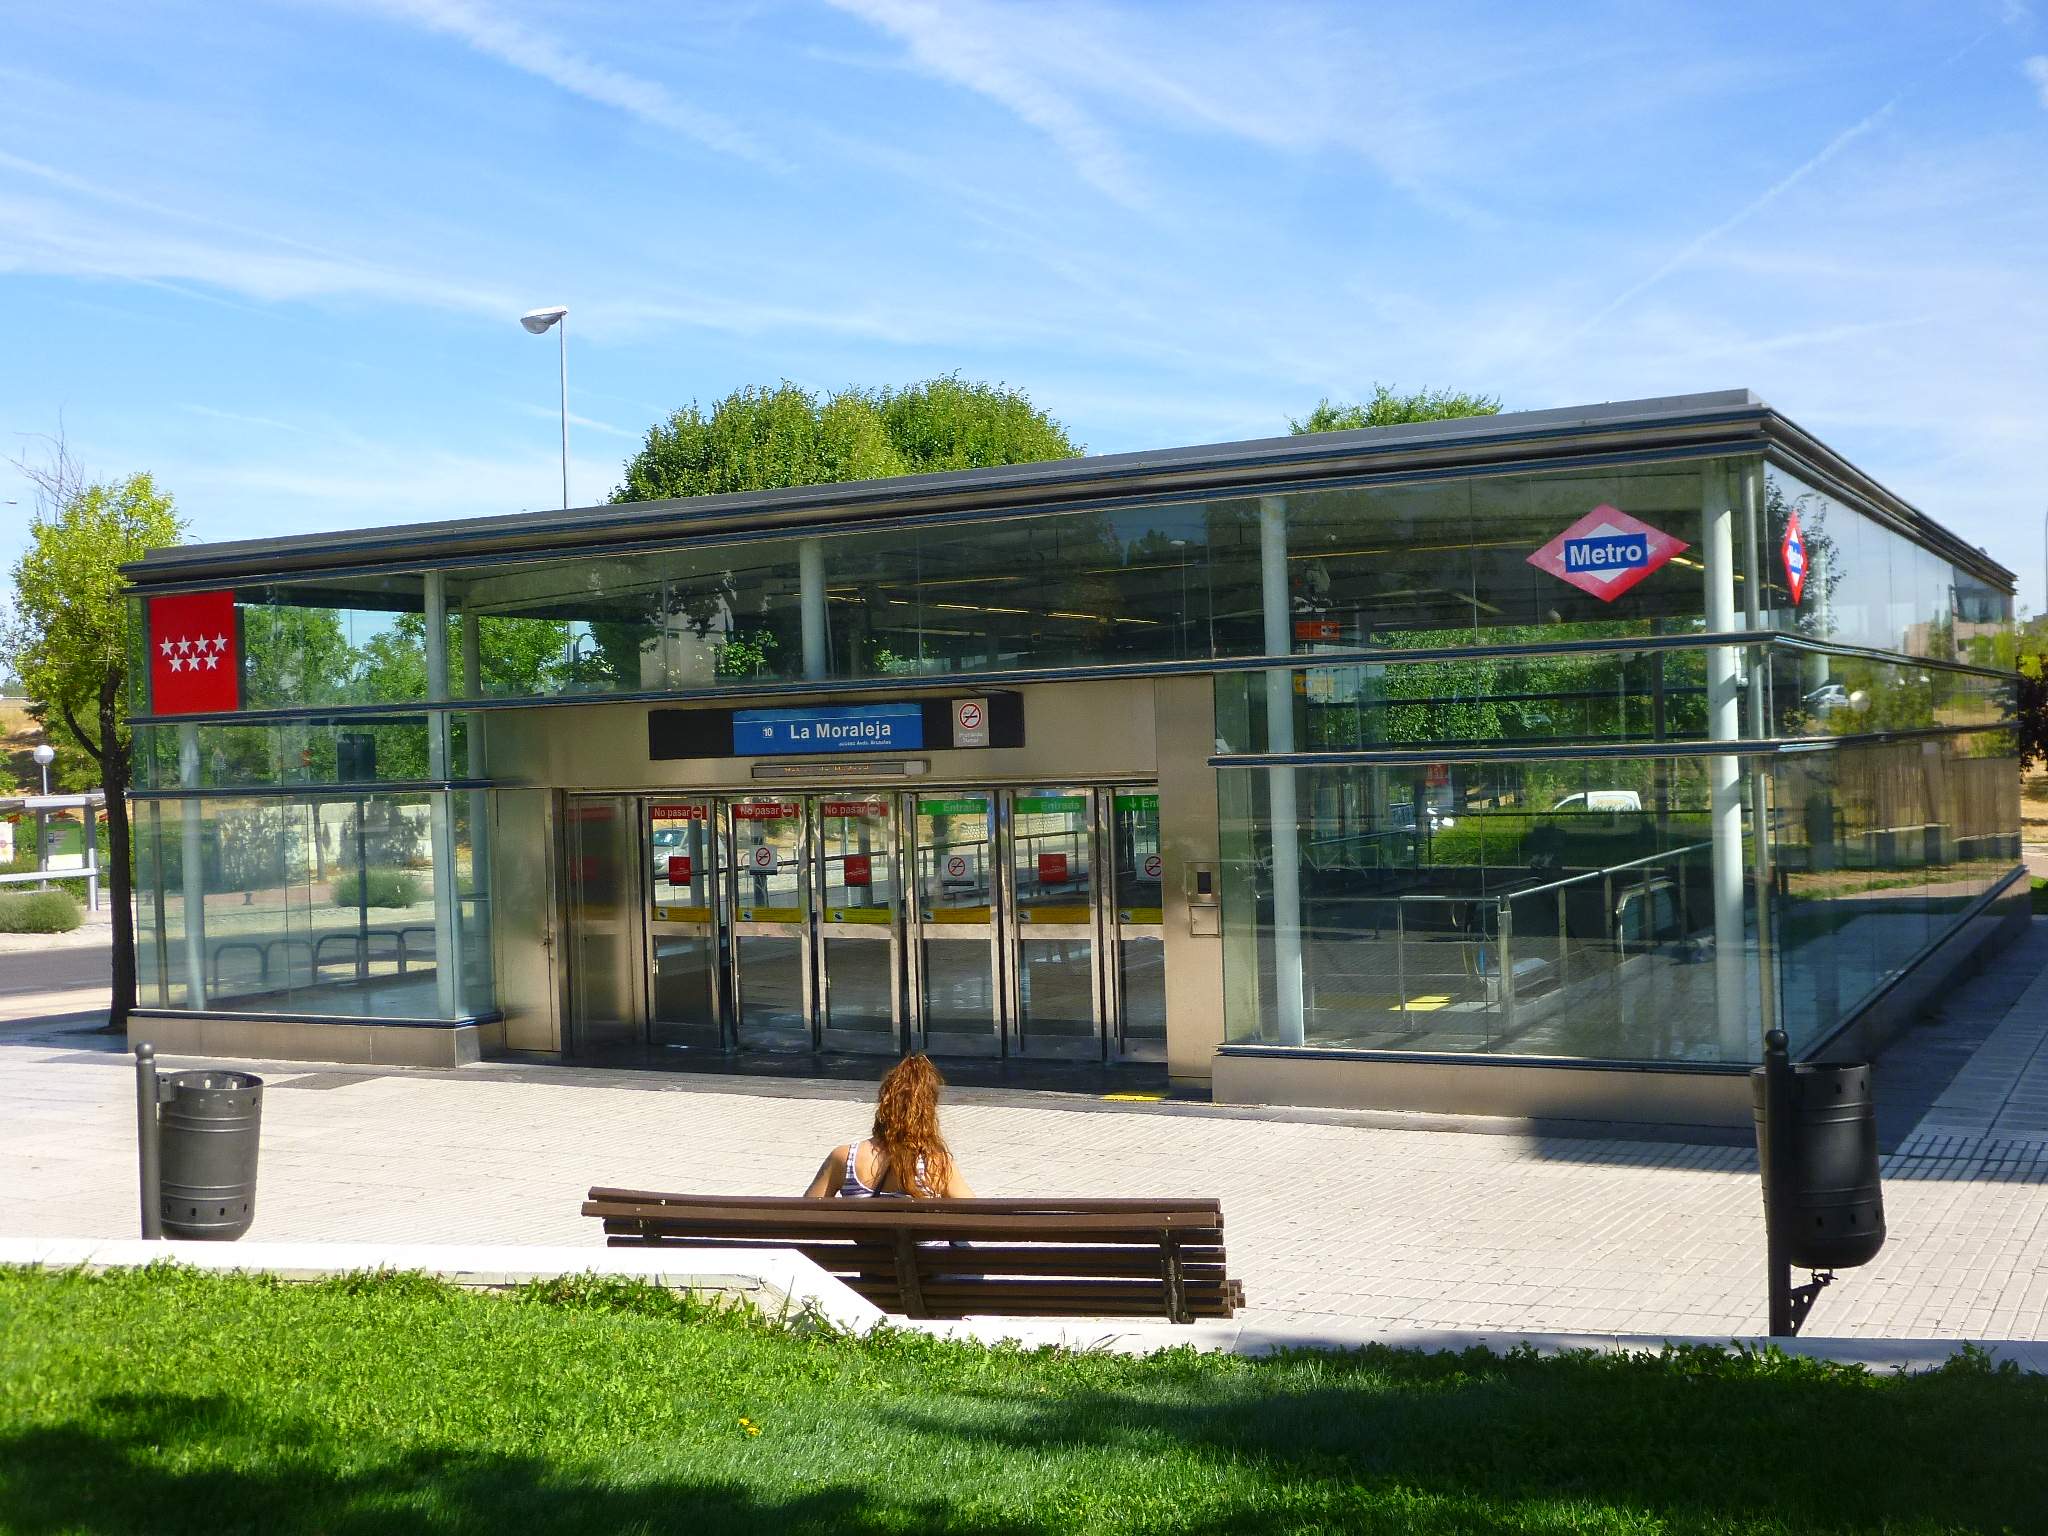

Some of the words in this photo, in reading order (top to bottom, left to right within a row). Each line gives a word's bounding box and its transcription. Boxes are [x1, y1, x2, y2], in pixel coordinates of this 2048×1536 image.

[1570, 543, 1642, 566] Metro
[790, 724, 810, 739] La
[815, 721, 891, 739] Moraleja
[654, 807, 666, 817] No
[667, 808, 691, 818] pasar
[740, 805, 753, 815] No
[755, 807, 780, 817] pasar
[824, 805, 838, 815] No
[840, 805, 866, 816] pasar
